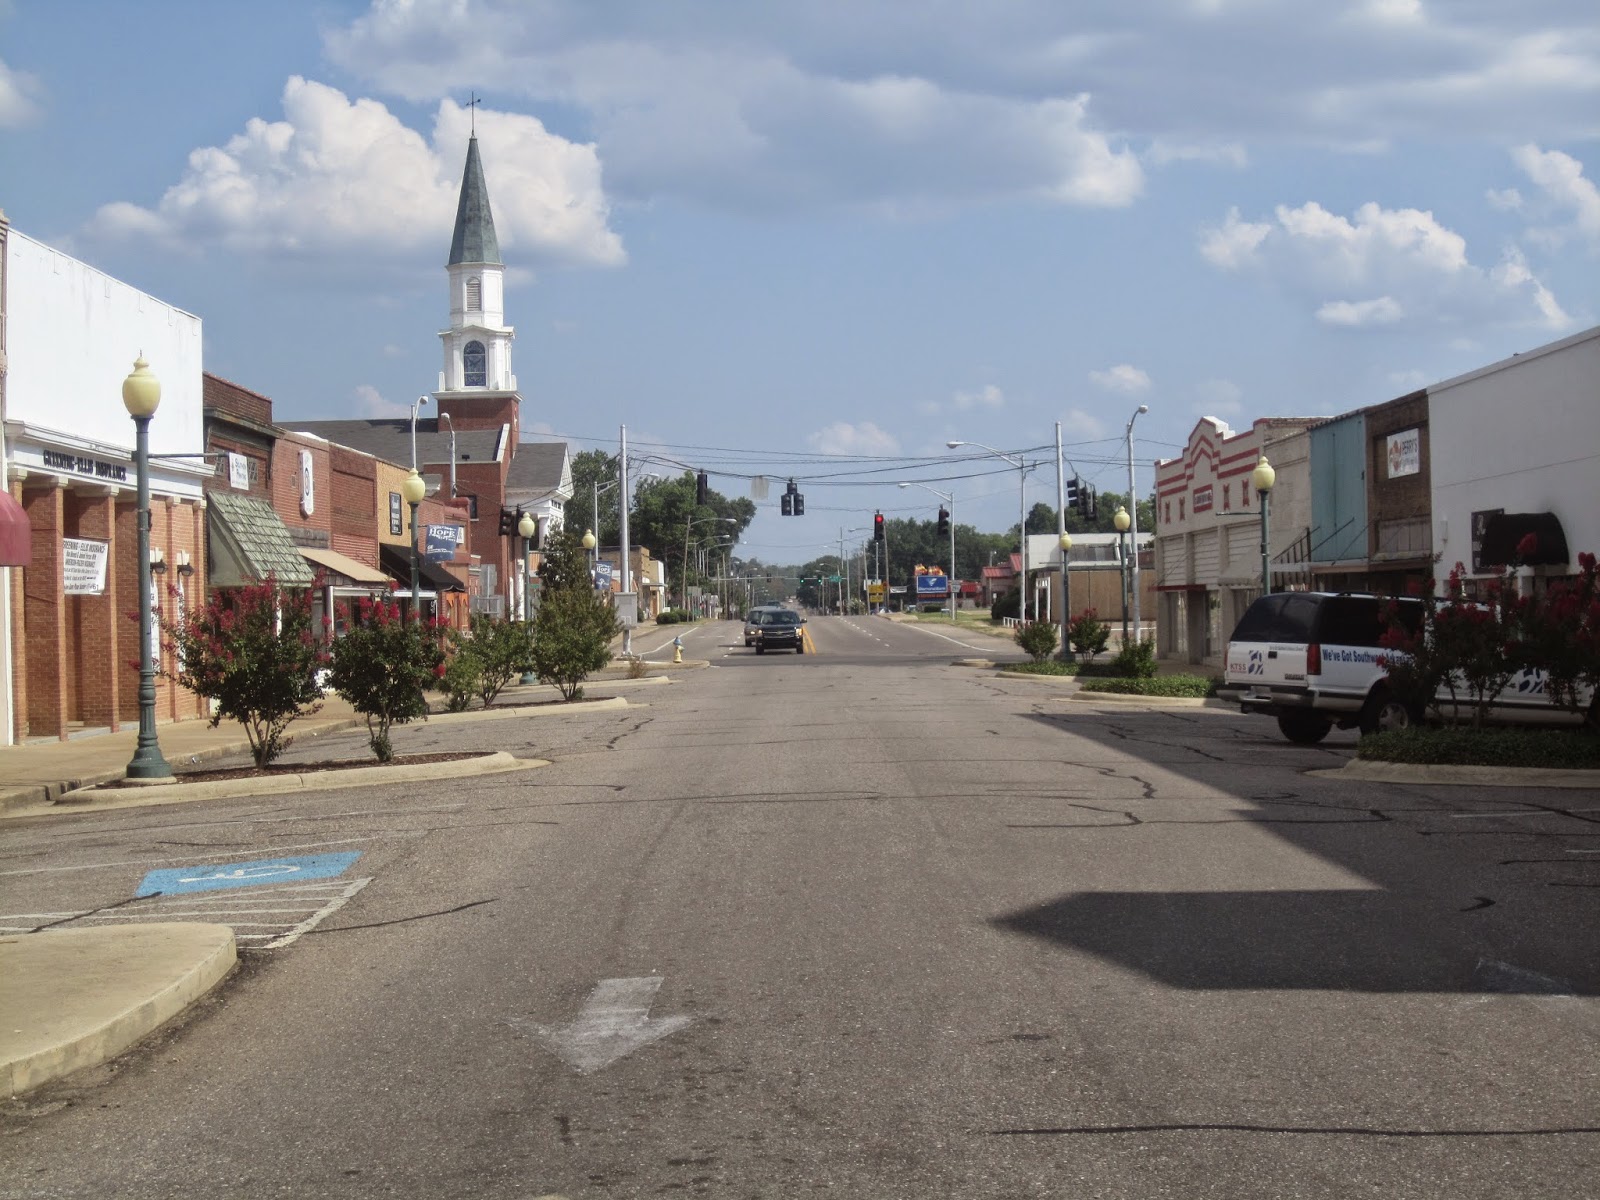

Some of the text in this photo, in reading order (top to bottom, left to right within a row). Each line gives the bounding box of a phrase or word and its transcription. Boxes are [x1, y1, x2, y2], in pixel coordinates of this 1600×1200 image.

[430, 528, 456, 537] HOPE
[1322, 649, 1341, 661] We've
[1341, 649, 1353, 662] Got
[1230, 663, 1247, 671] KTSS
